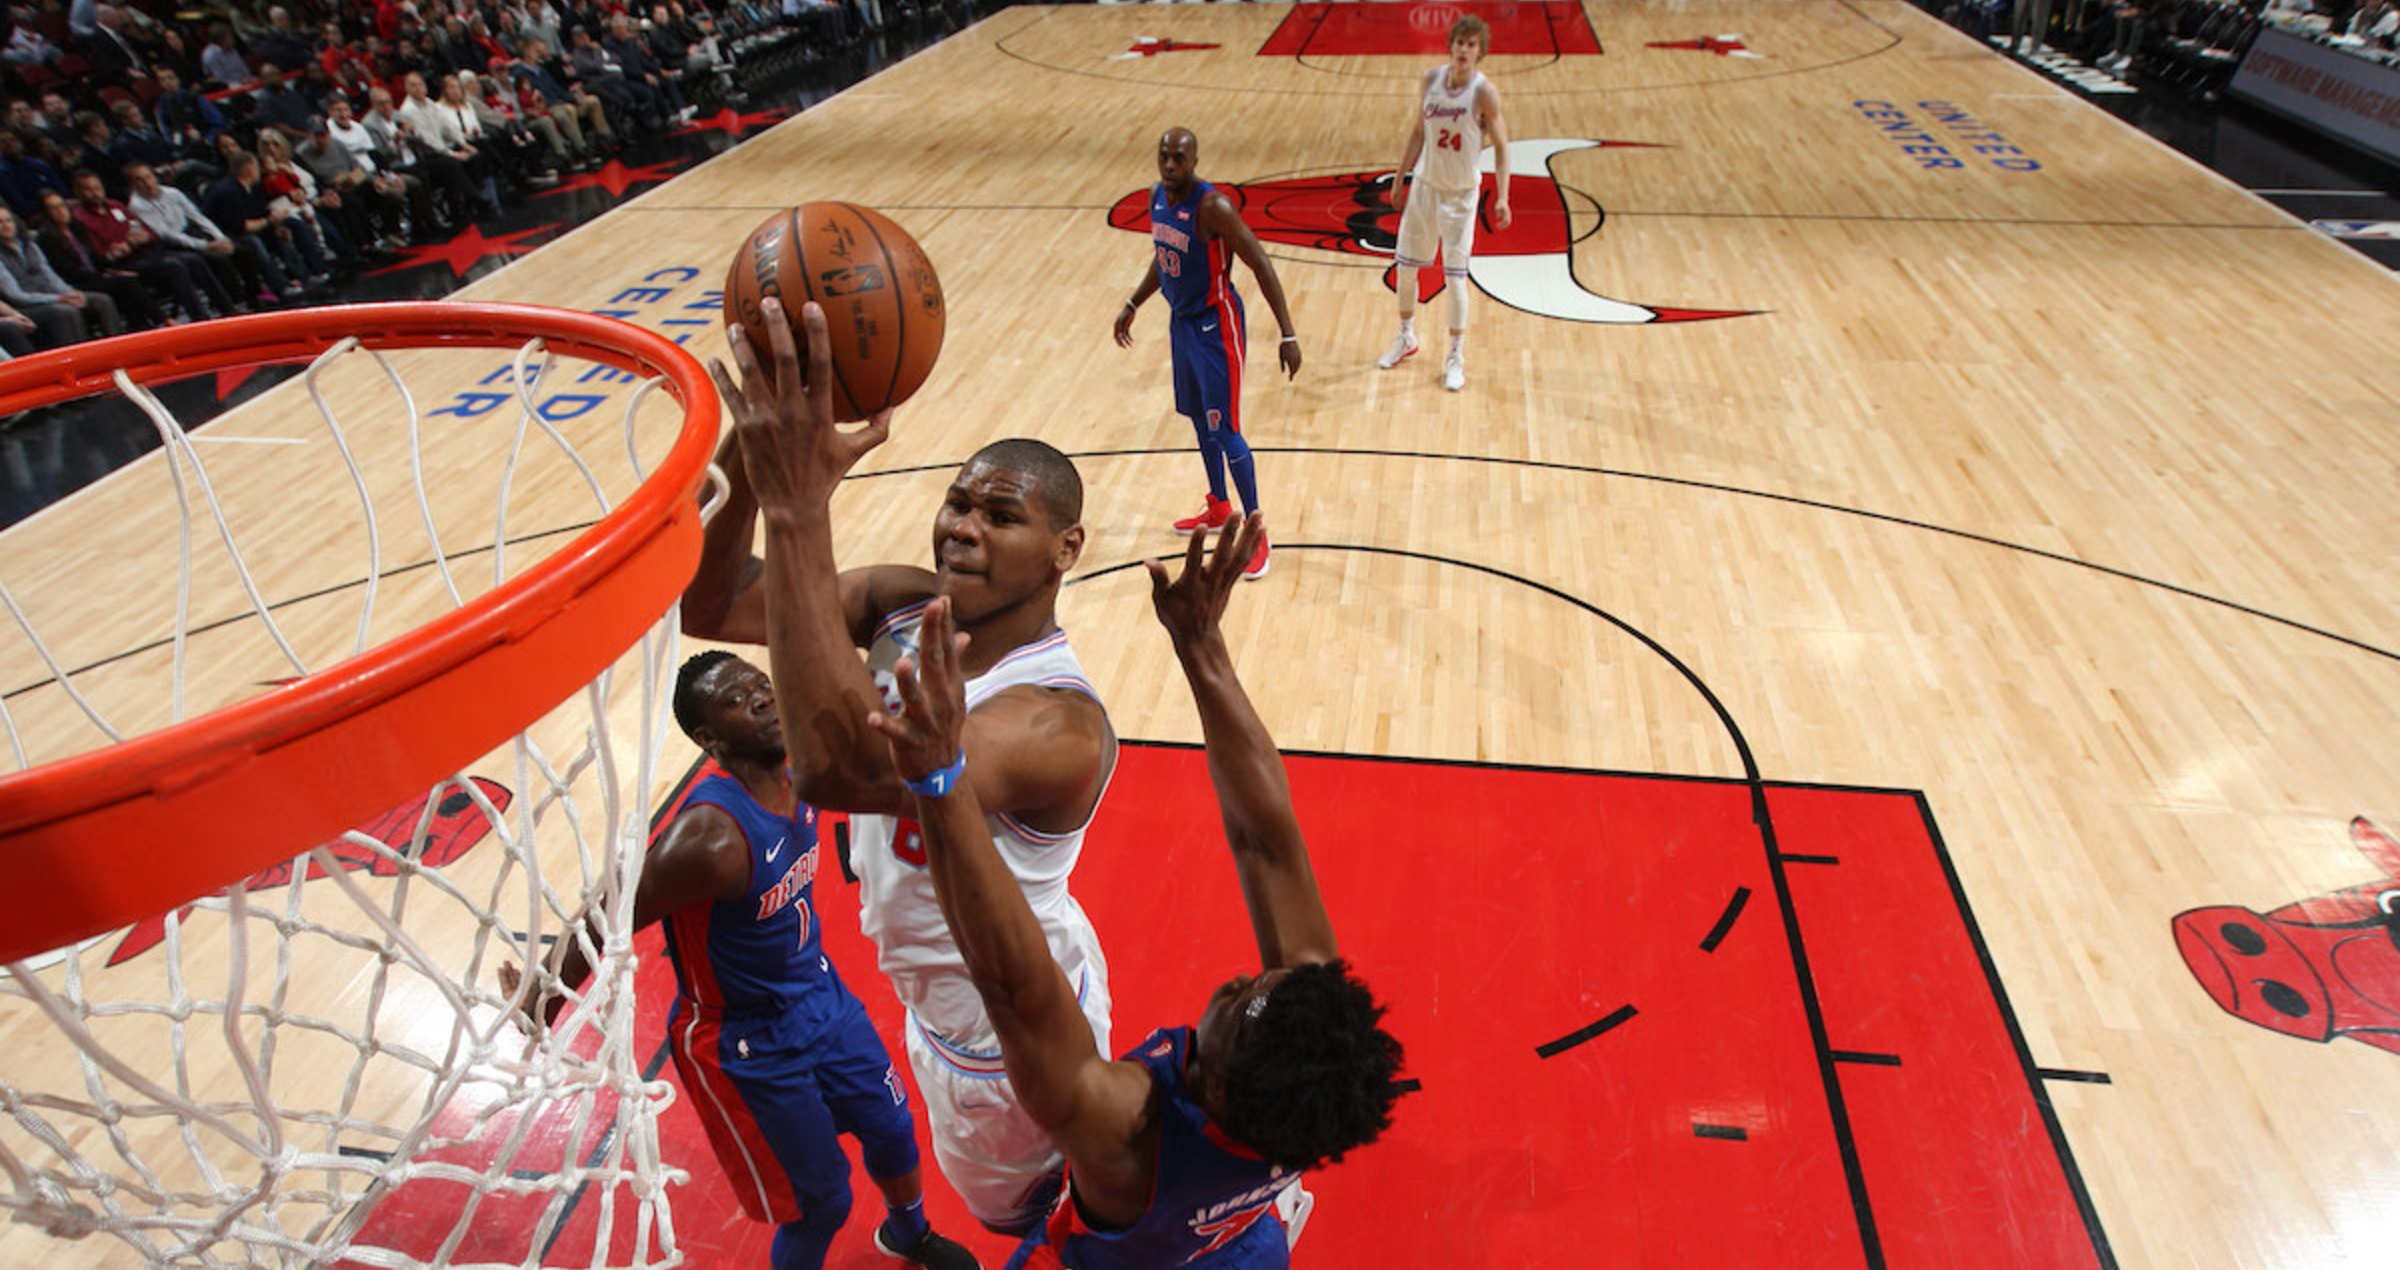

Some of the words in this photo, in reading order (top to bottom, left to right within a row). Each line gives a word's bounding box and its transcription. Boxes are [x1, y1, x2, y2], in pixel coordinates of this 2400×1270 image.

[1437, 129, 1461, 152] 24
[1853, 101, 1965, 168] CENTER
[1917, 101, 2042, 171] UNITED
[932, 774, 945, 793] 7
[756, 841, 819, 919] DETRO
